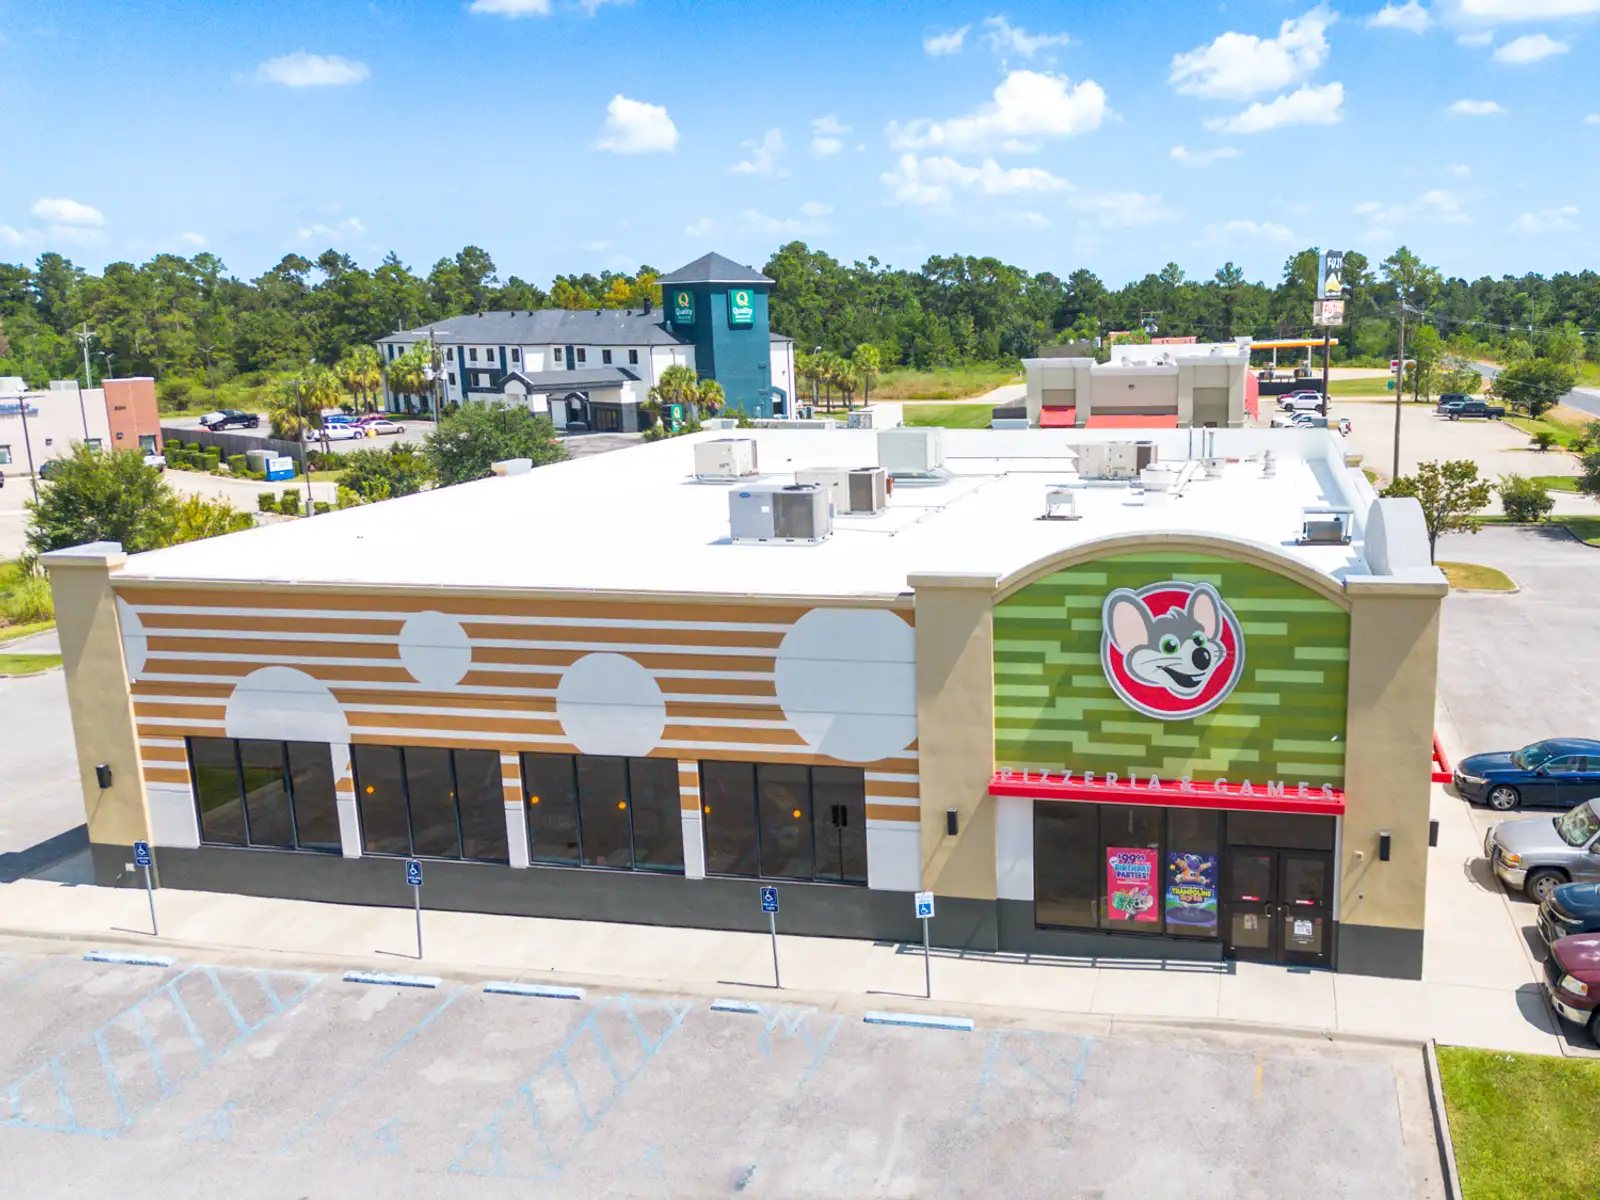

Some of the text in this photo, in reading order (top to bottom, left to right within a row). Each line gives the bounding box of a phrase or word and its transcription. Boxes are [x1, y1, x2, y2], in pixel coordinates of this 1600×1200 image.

[1327, 257, 1342, 269] FUJI
[678, 292, 689, 307] Q
[736, 291, 749, 306] Q
[733, 307, 753, 315] Quality
[1000, 766, 1334, 800] PIZZERIA & GAMES
[1114, 863, 1151, 872] BIRTHDAY
[1171, 887, 1212, 897] TRAMPOLINE
